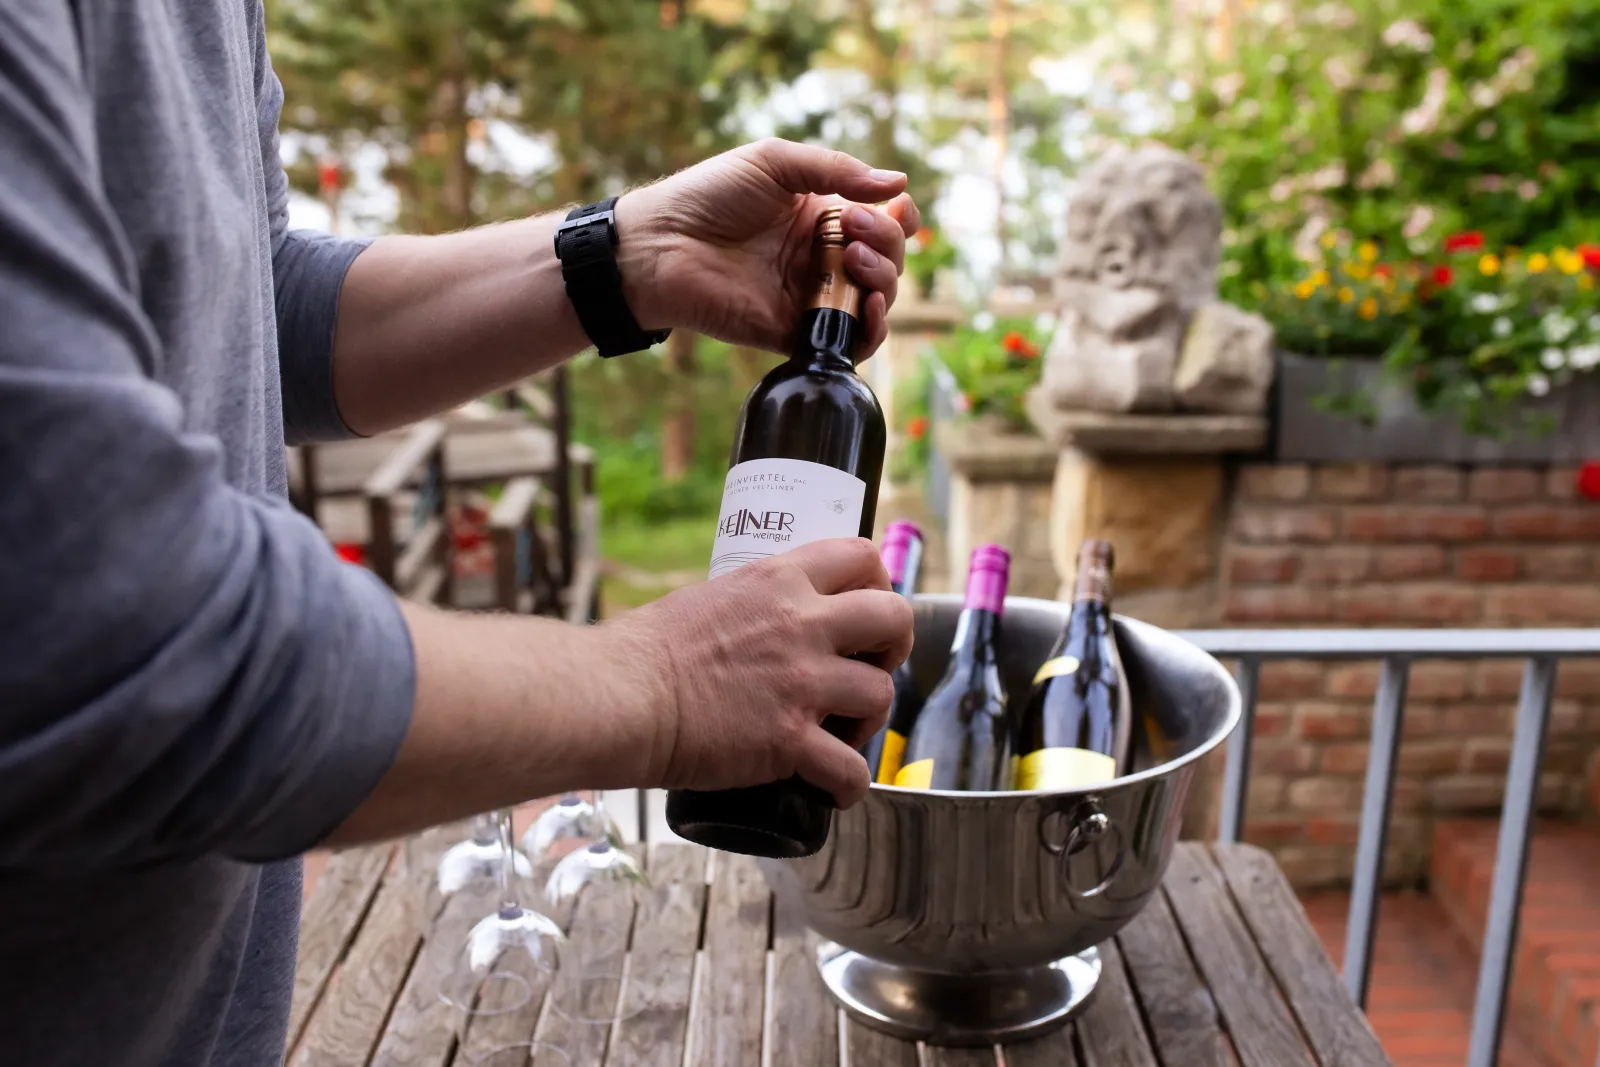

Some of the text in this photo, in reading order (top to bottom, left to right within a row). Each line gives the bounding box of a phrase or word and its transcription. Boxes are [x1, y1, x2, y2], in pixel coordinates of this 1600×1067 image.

[752, 484, 794, 492] VELTLINER
[718, 509, 794, 537] KELLNER
[752, 531, 791, 542] weingut
